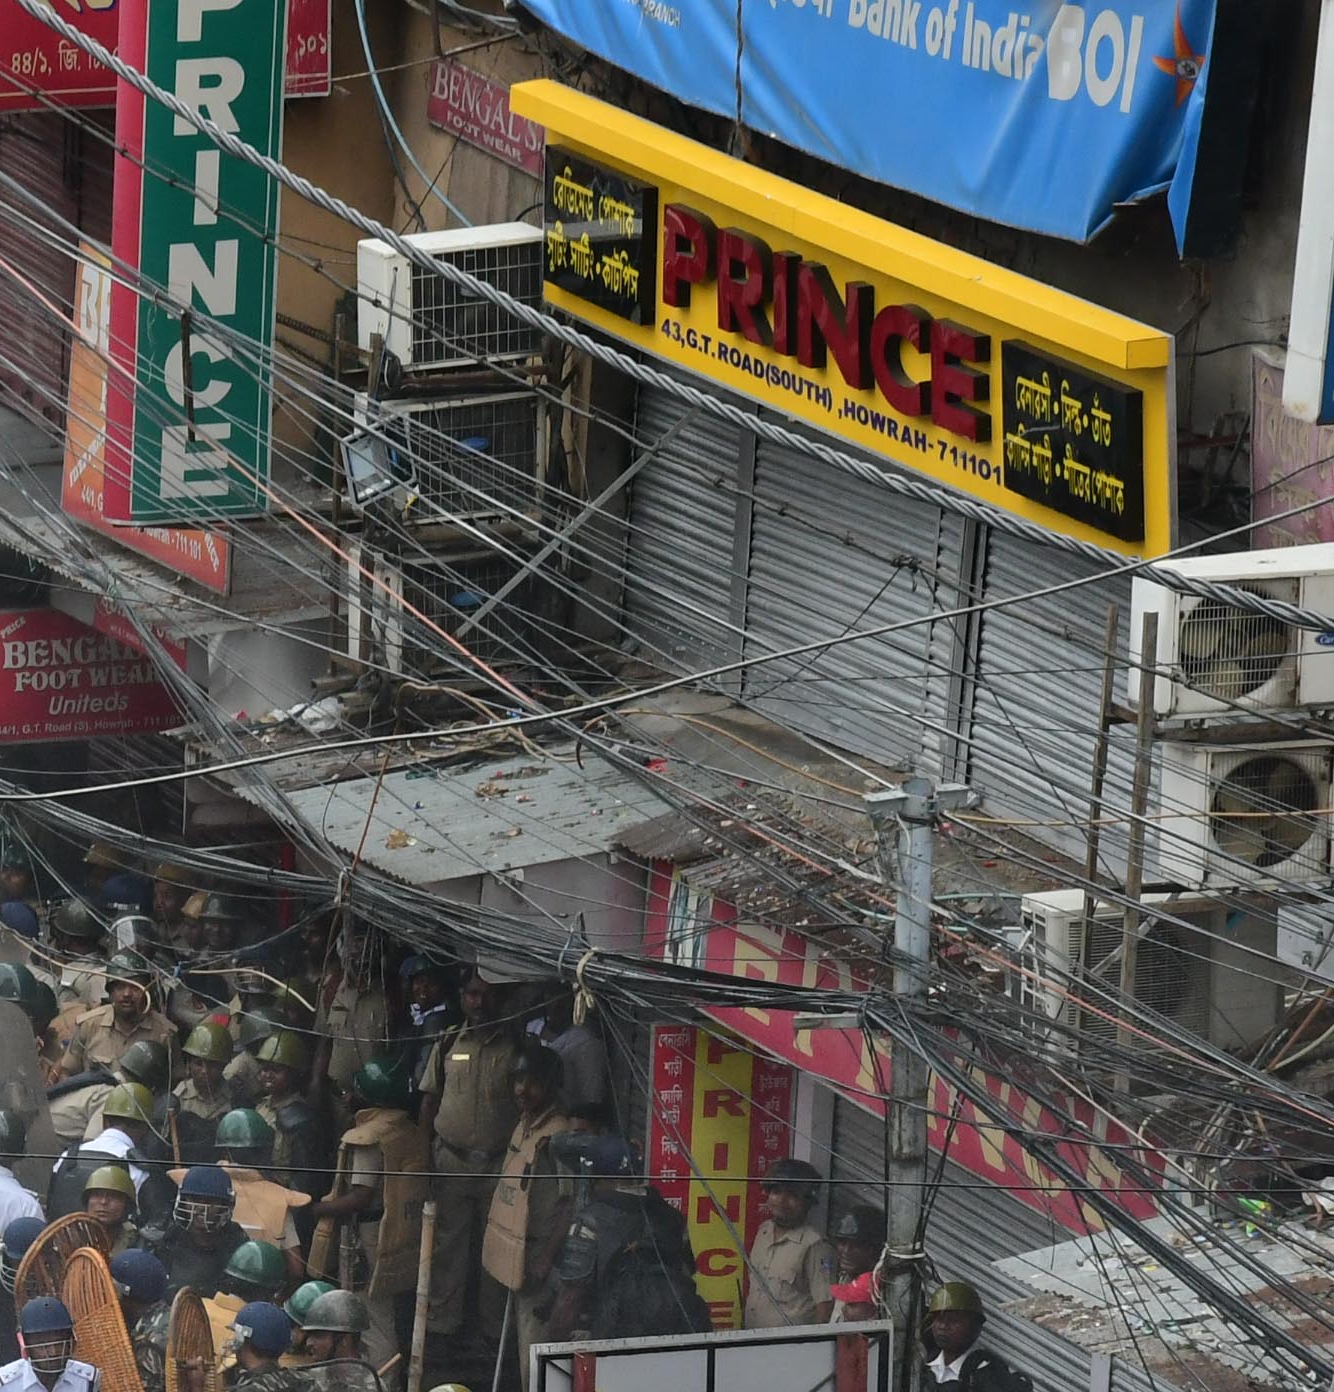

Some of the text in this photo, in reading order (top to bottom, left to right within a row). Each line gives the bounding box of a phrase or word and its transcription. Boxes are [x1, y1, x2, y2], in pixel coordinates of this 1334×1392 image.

[925, 0, 959, 60] of
[962, 1, 1044, 80] India
[1047, 4, 1144, 113] BOI
[482, 130, 522, 162] WEAR
[160, 0, 246, 497] PRINCE
[663, 203, 992, 444] PRINCE
[938, 439, 1002, 486] 711101
[0, 616, 27, 643] PRICE
[14, 664, 162, 693] FOOT WEAR
[44, 720, 72, 733] Road
[48, 692, 129, 716] Uniteds
[696, 1033, 747, 1330] PRINCE
